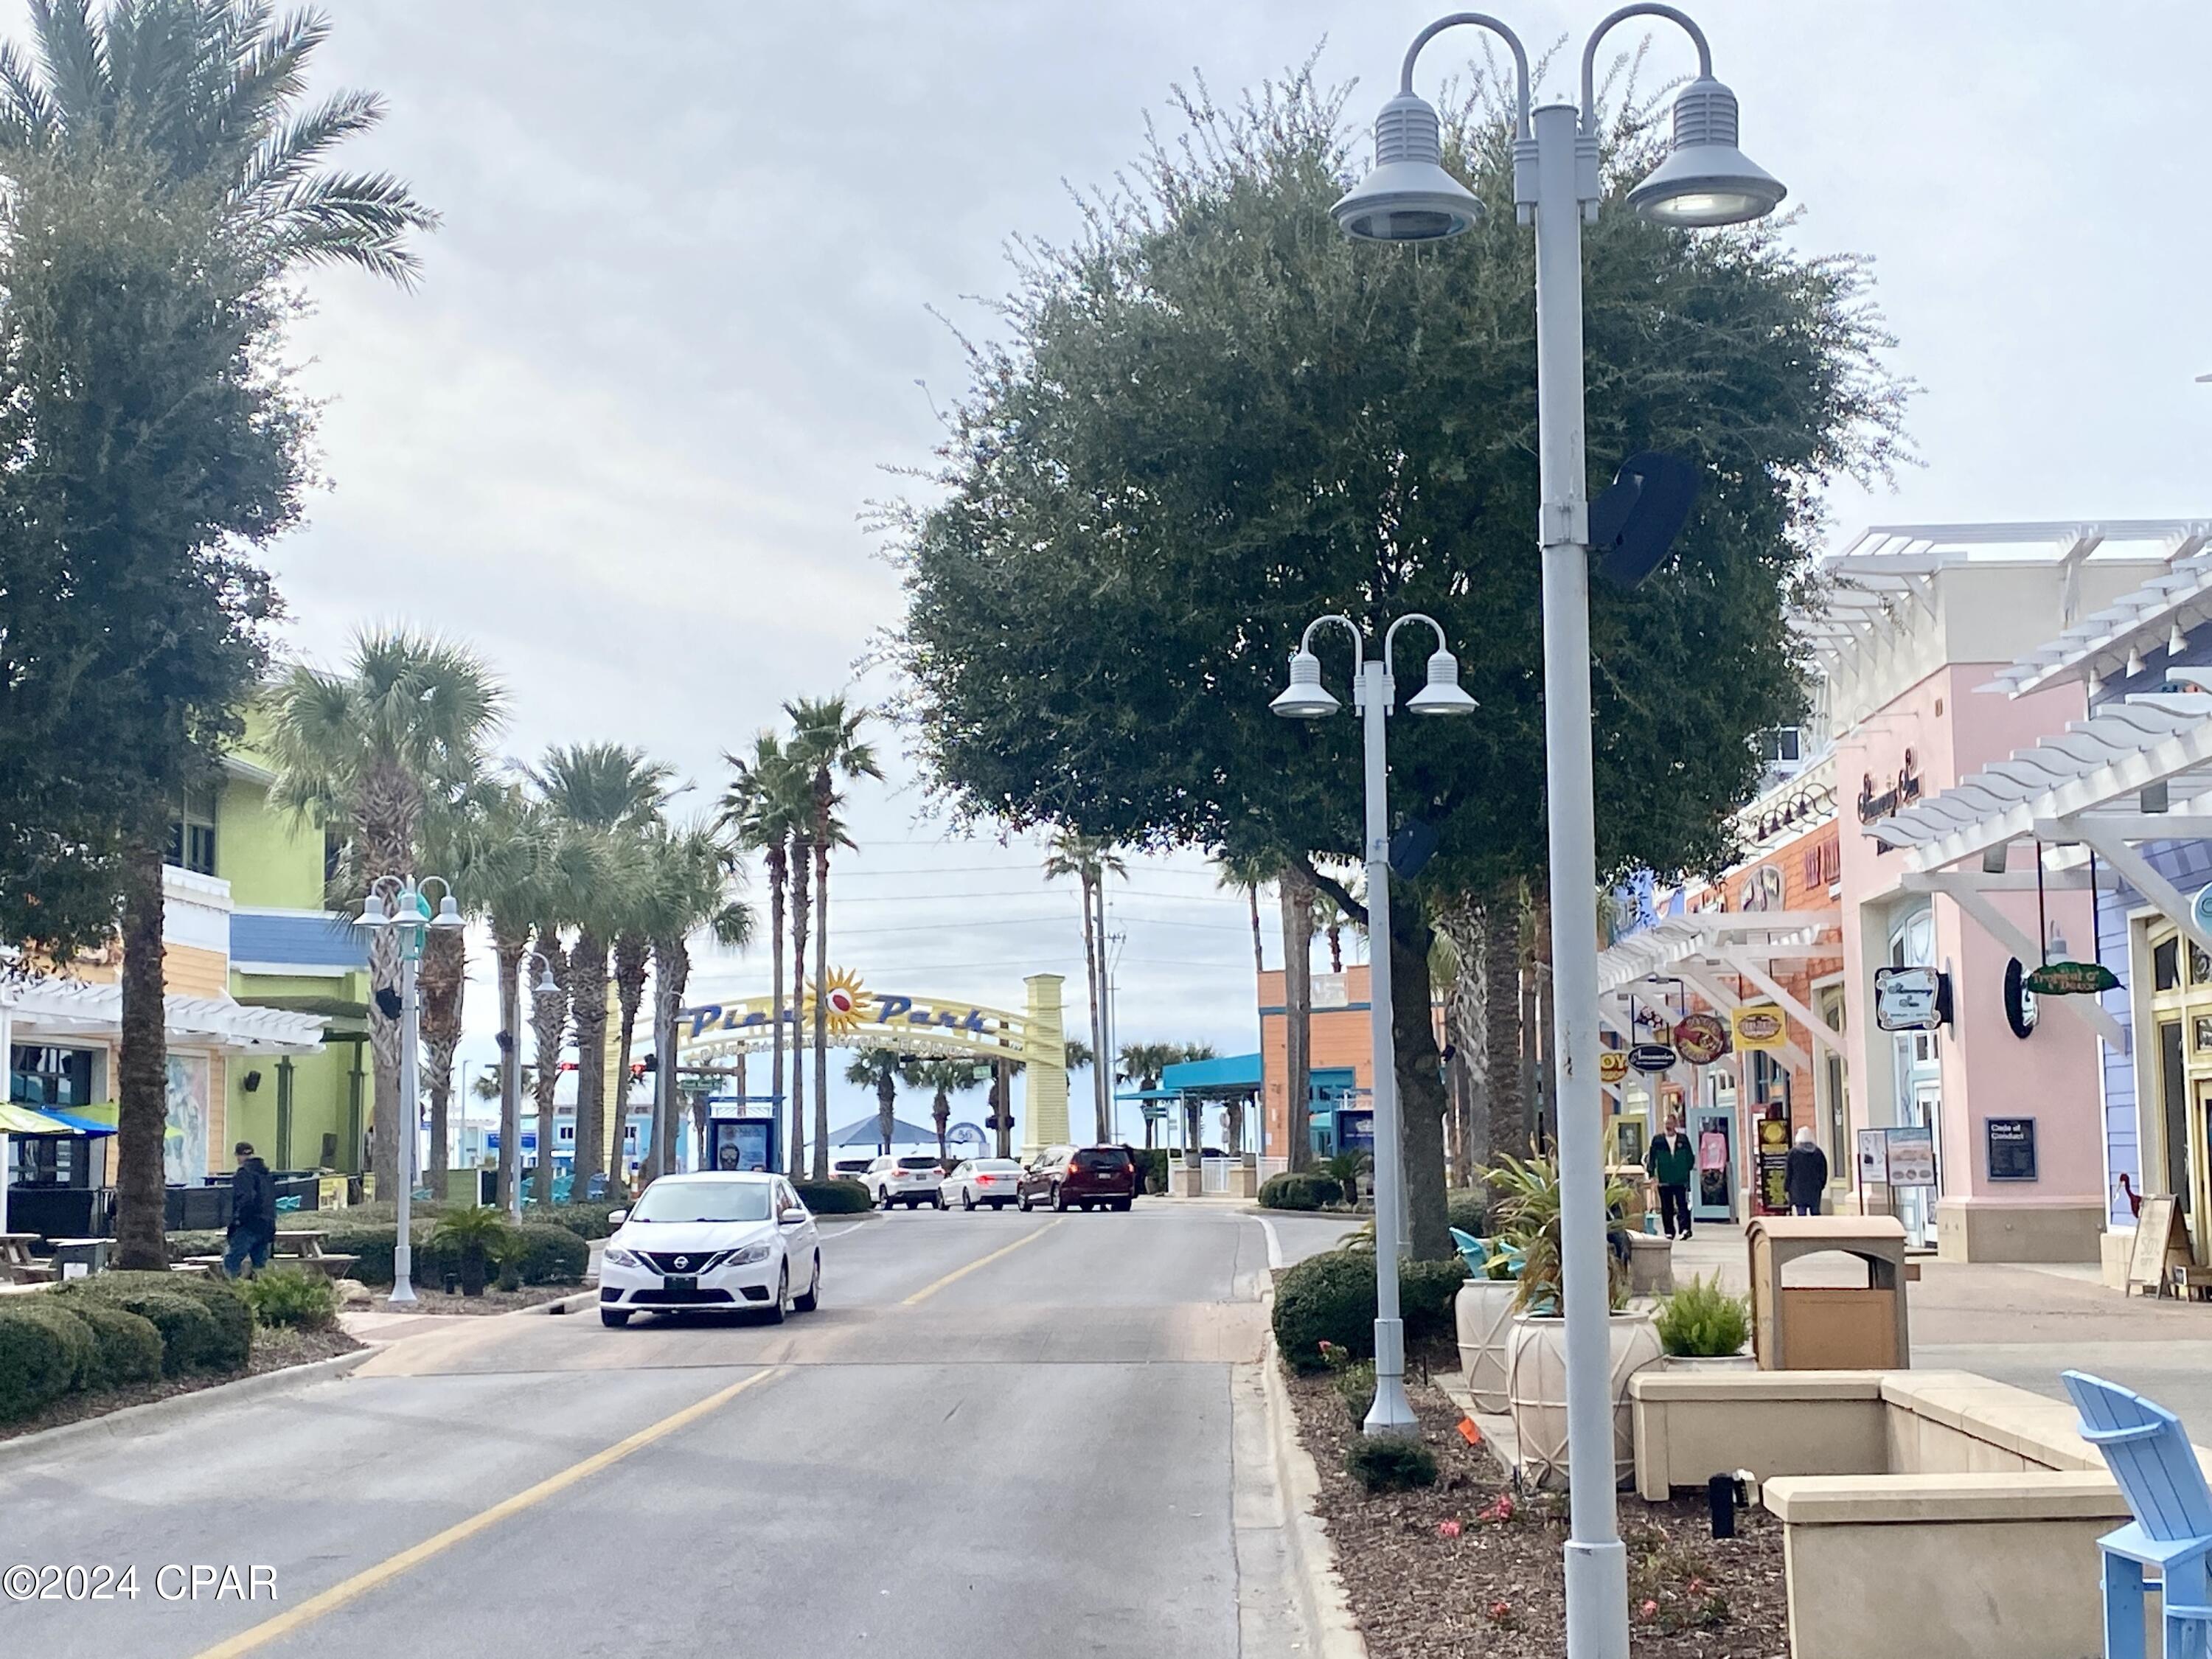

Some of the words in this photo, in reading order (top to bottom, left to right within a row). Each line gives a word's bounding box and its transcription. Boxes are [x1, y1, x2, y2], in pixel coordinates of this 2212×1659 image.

[872, 994, 997, 1034] Park
[783, 1037, 815, 1050] CTY
[899, 1037, 976, 1057] FLORIDA
